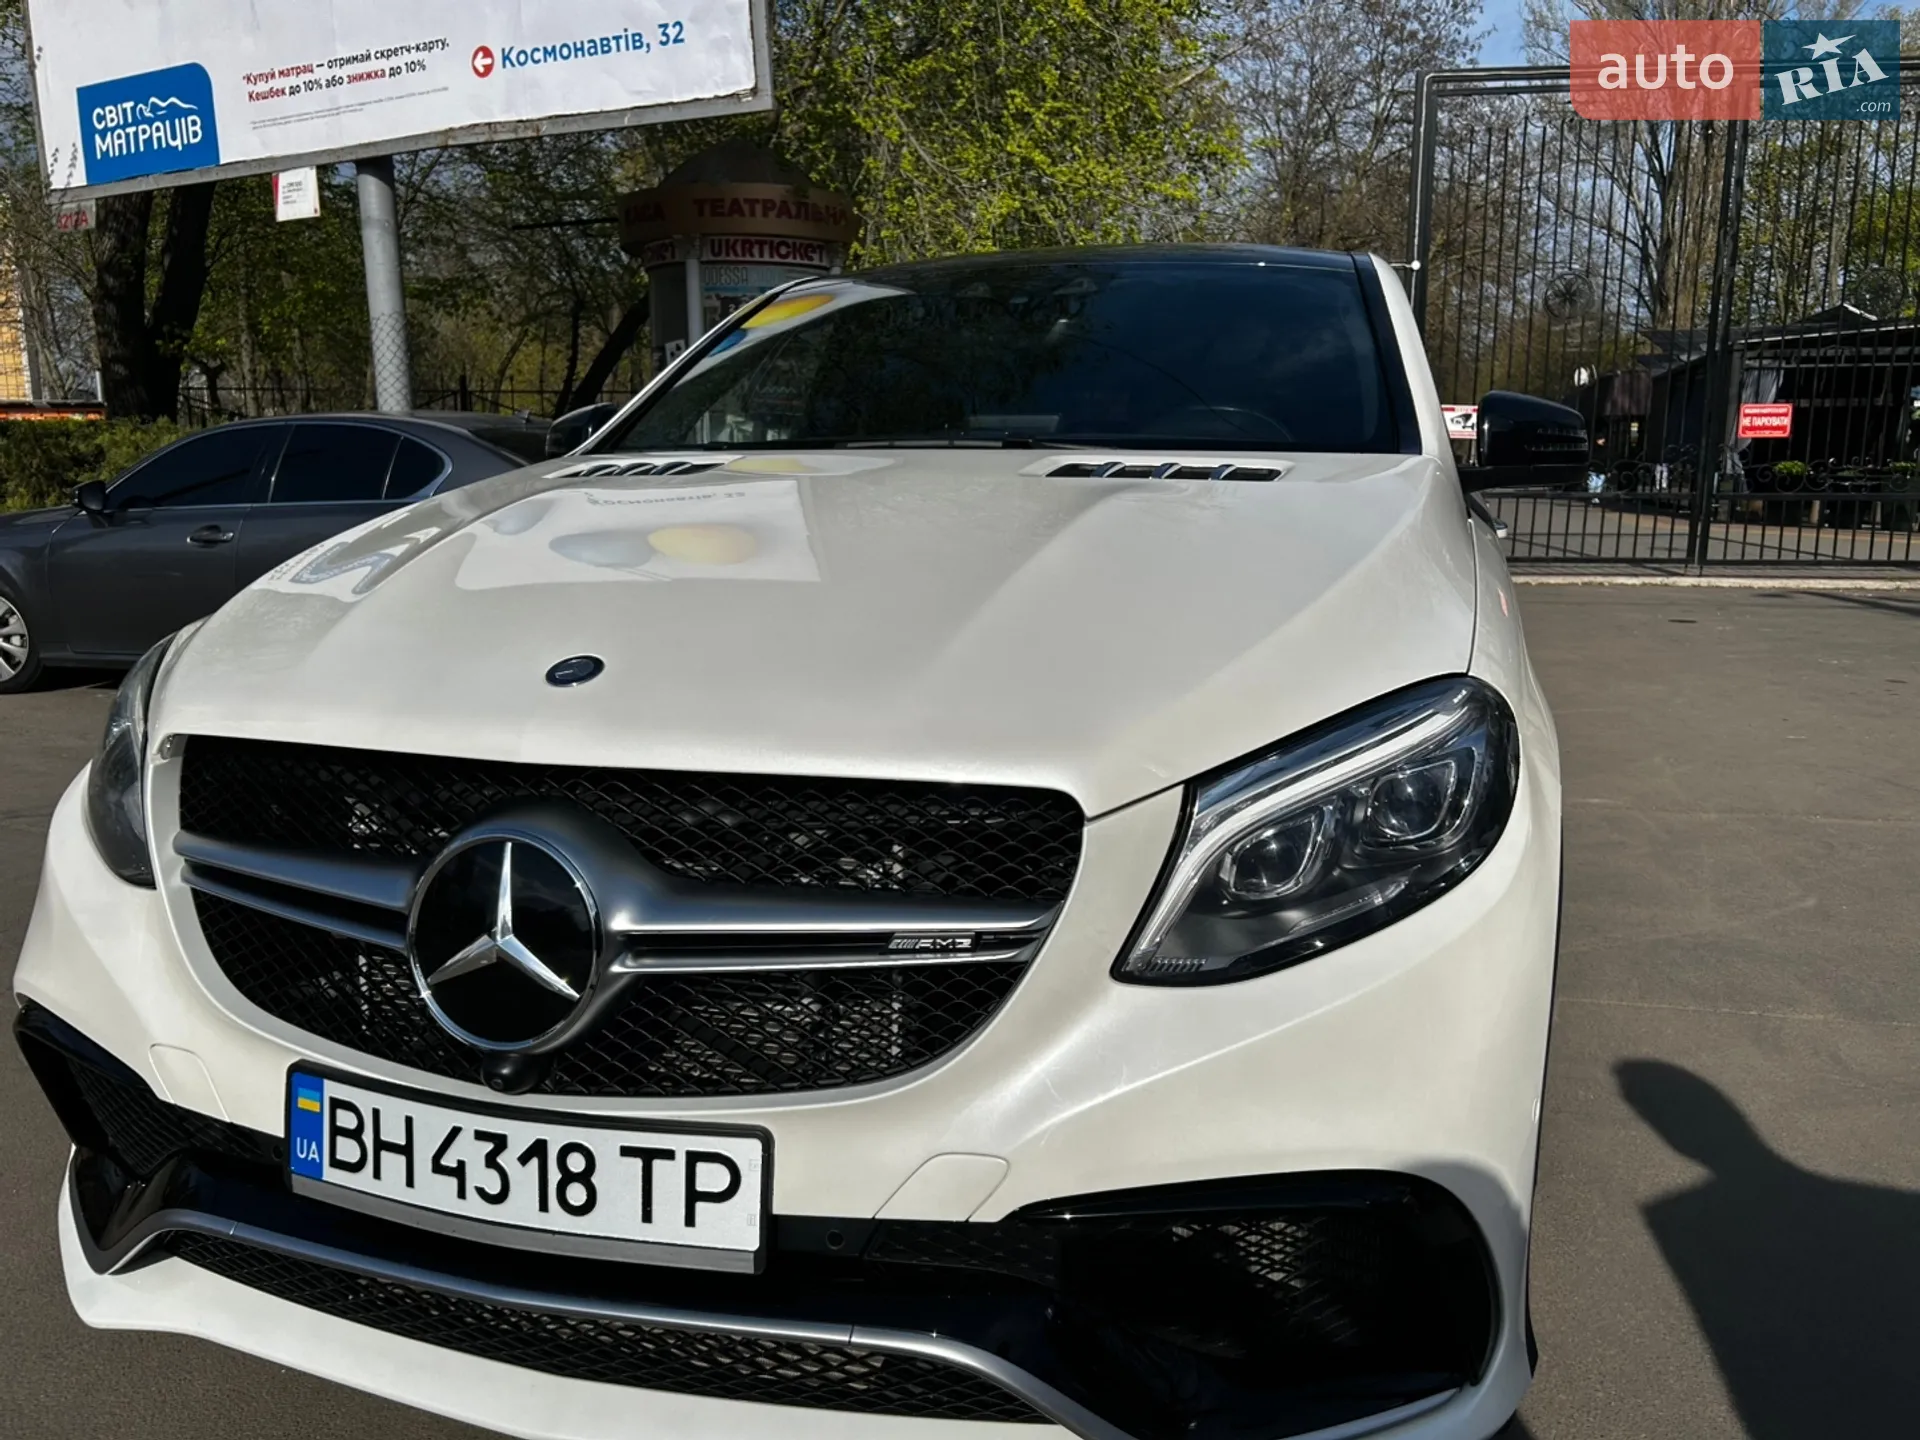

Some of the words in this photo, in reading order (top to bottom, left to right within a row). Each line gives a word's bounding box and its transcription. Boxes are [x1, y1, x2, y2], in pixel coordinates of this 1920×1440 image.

[278, 63, 314, 80] матрац
[327, 50, 372, 70] отримай
[501, 28, 651, 69] Космонавтів,
[657, 20, 685, 47] 32
[248, 86, 287, 103] Кешбек
[288, 84, 301, 97] до
[303, 79, 323, 94] 10%
[325, 76, 344, 89] або
[346, 69, 386, 85] знижка
[388, 65, 402, 79] до
[404, 59, 427, 74] 10%
[92, 101, 135, 129] СВІТ
[94, 115, 203, 160] МАТРАЦІВ
[296, 1136, 320, 1164] UA
[328, 1095, 415, 1189] BH
[431, 1124, 599, 1218] 4318
[619, 1144, 742, 1228] TP
